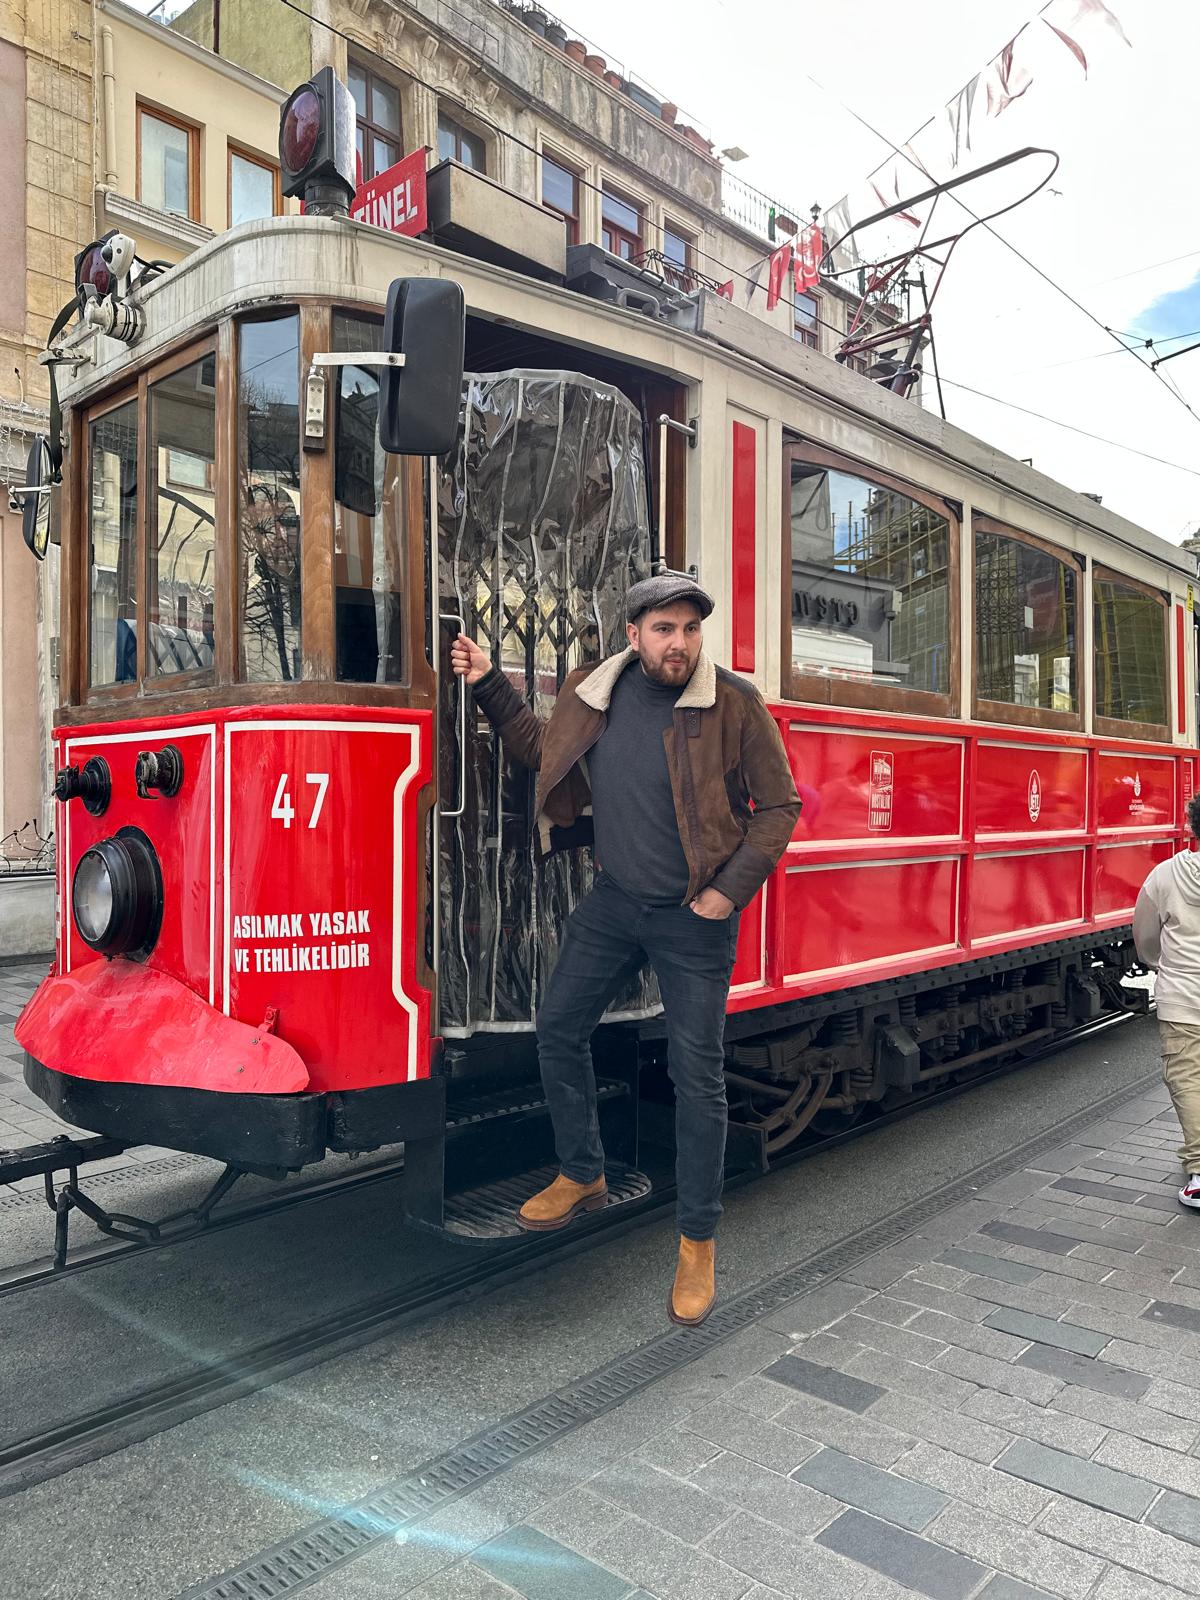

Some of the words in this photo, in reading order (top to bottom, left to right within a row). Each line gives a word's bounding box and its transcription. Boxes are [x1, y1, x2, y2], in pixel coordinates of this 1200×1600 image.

[353, 179, 418, 230] TÜNEL
[271, 773, 330, 829] 47
[233, 914, 303, 938] ASILMAK
[309, 910, 371, 936] YASAK
[234, 948, 250, 973] VE
[254, 940, 370, 973] TEHLİKELİDİR
